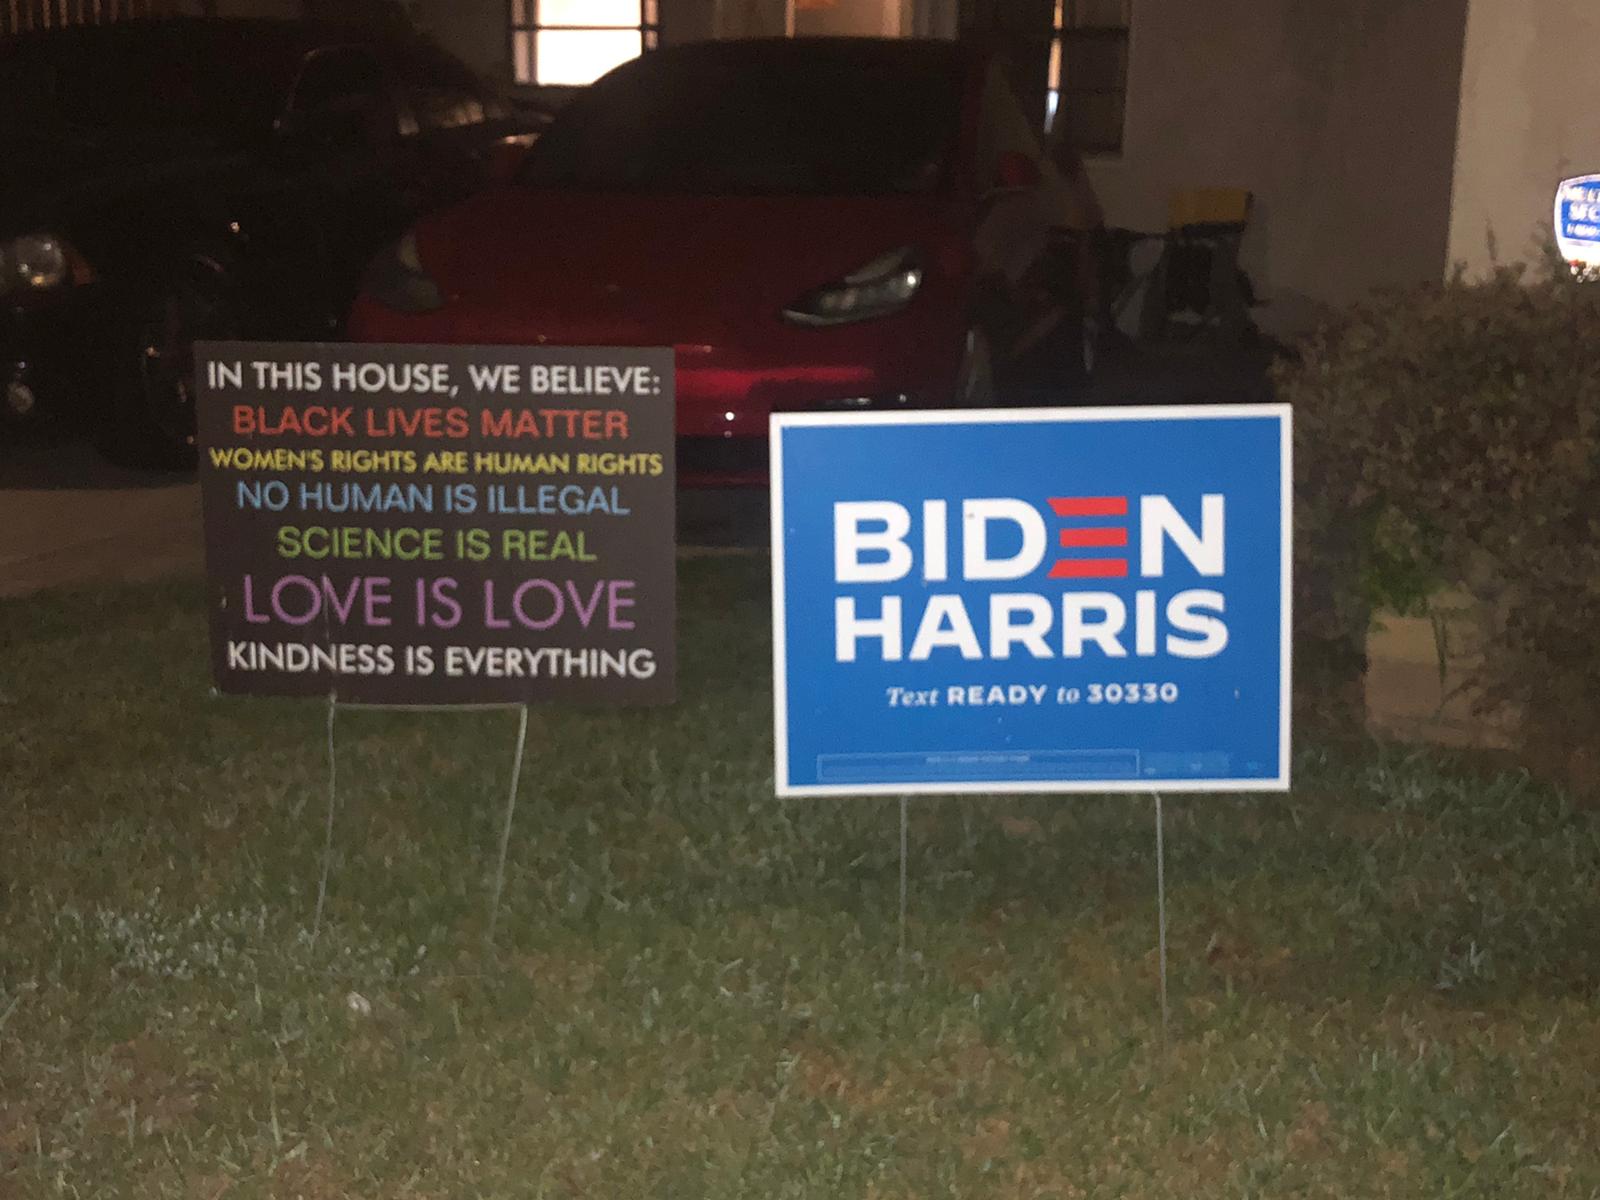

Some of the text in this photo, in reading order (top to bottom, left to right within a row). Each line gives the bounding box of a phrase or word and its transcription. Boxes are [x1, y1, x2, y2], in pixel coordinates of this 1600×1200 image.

[208, 361, 660, 397] IN THIS HOUSE, WE BELIEVE:
[233, 405, 629, 439] BLACK LIVES MATTER
[209, 447, 663, 476] WOMEN'S RIGHTS ARE HUMAN RIGHTS
[237, 480, 630, 515] NO HUMAN IS ILLEGAL
[278, 526, 598, 562] SCIENCE IS REAL
[833, 494, 1225, 583] BIDEN
[244, 574, 636, 630] LOVE IS LOVE
[835, 589, 1229, 662] HARRIS
[228, 641, 656, 679] KINDNESS IS EVERYTHING
[886, 682, 1178, 707] Text READY to 30330
